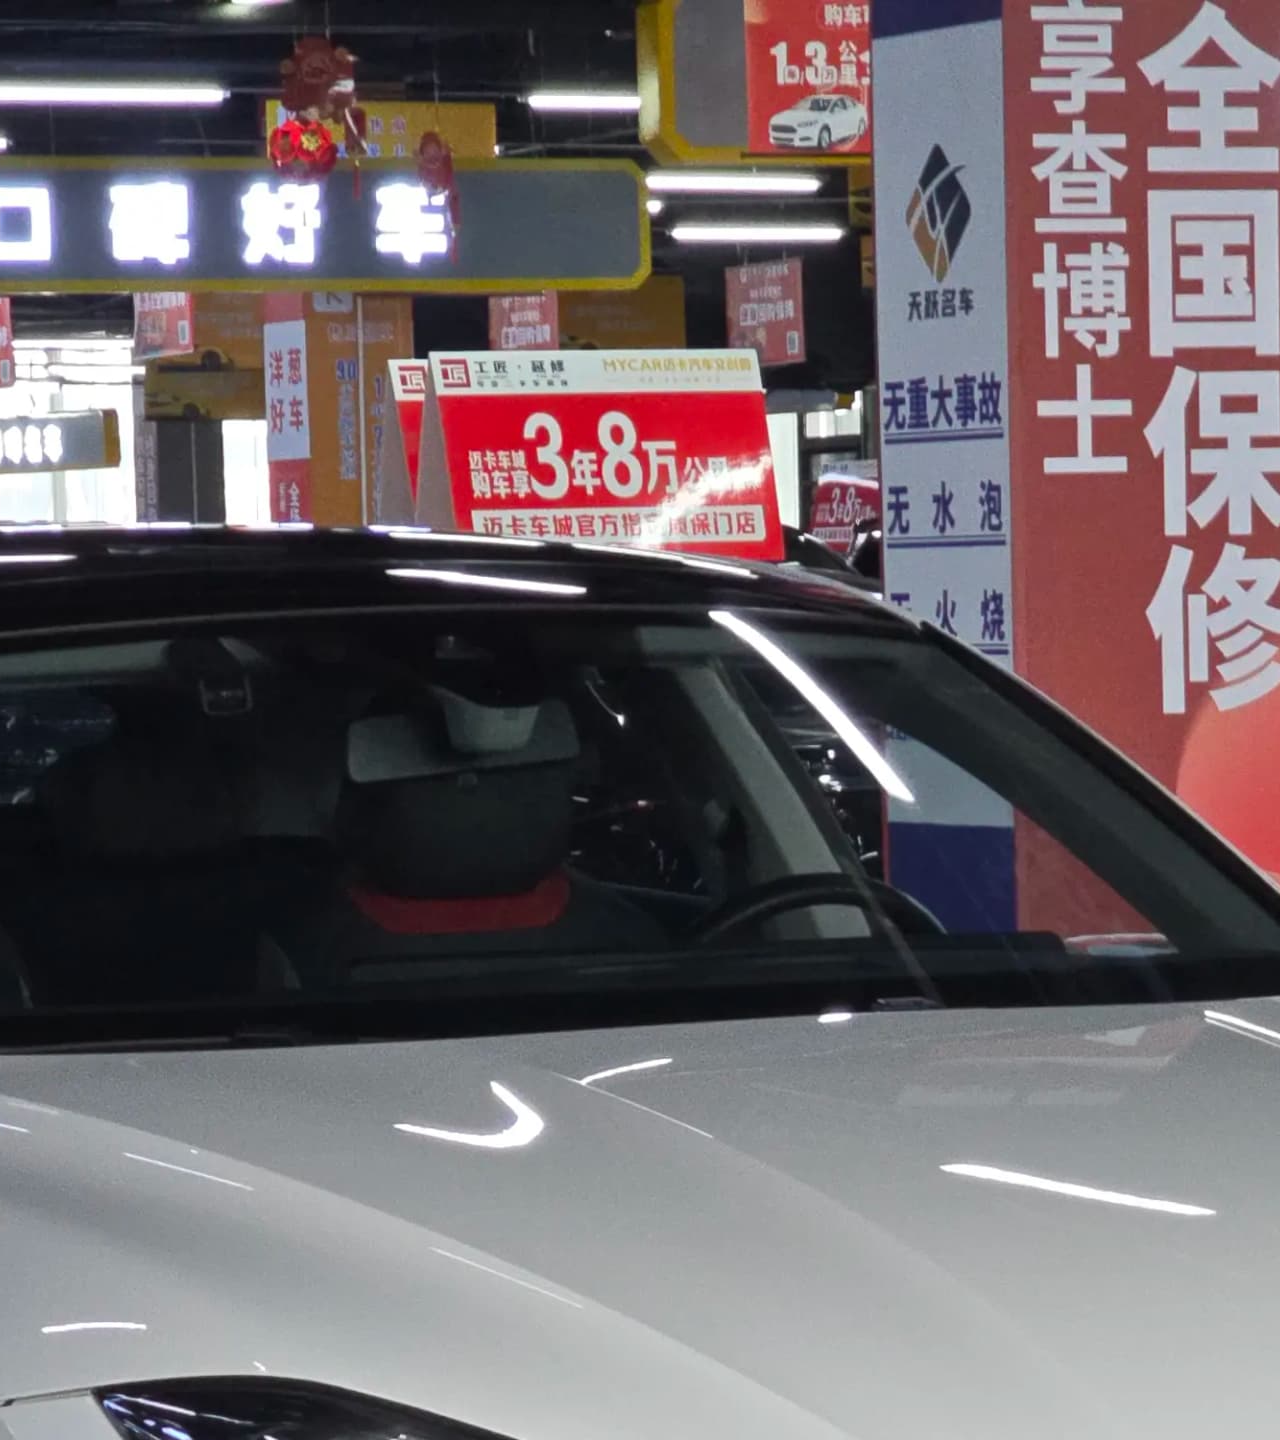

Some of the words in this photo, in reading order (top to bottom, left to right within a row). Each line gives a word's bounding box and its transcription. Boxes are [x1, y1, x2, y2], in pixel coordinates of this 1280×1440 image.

[908, 287, 975, 322] 天跃名车
[884, 372, 1003, 433] 无重大事故
[887, 480, 1003, 535] 无水泡
